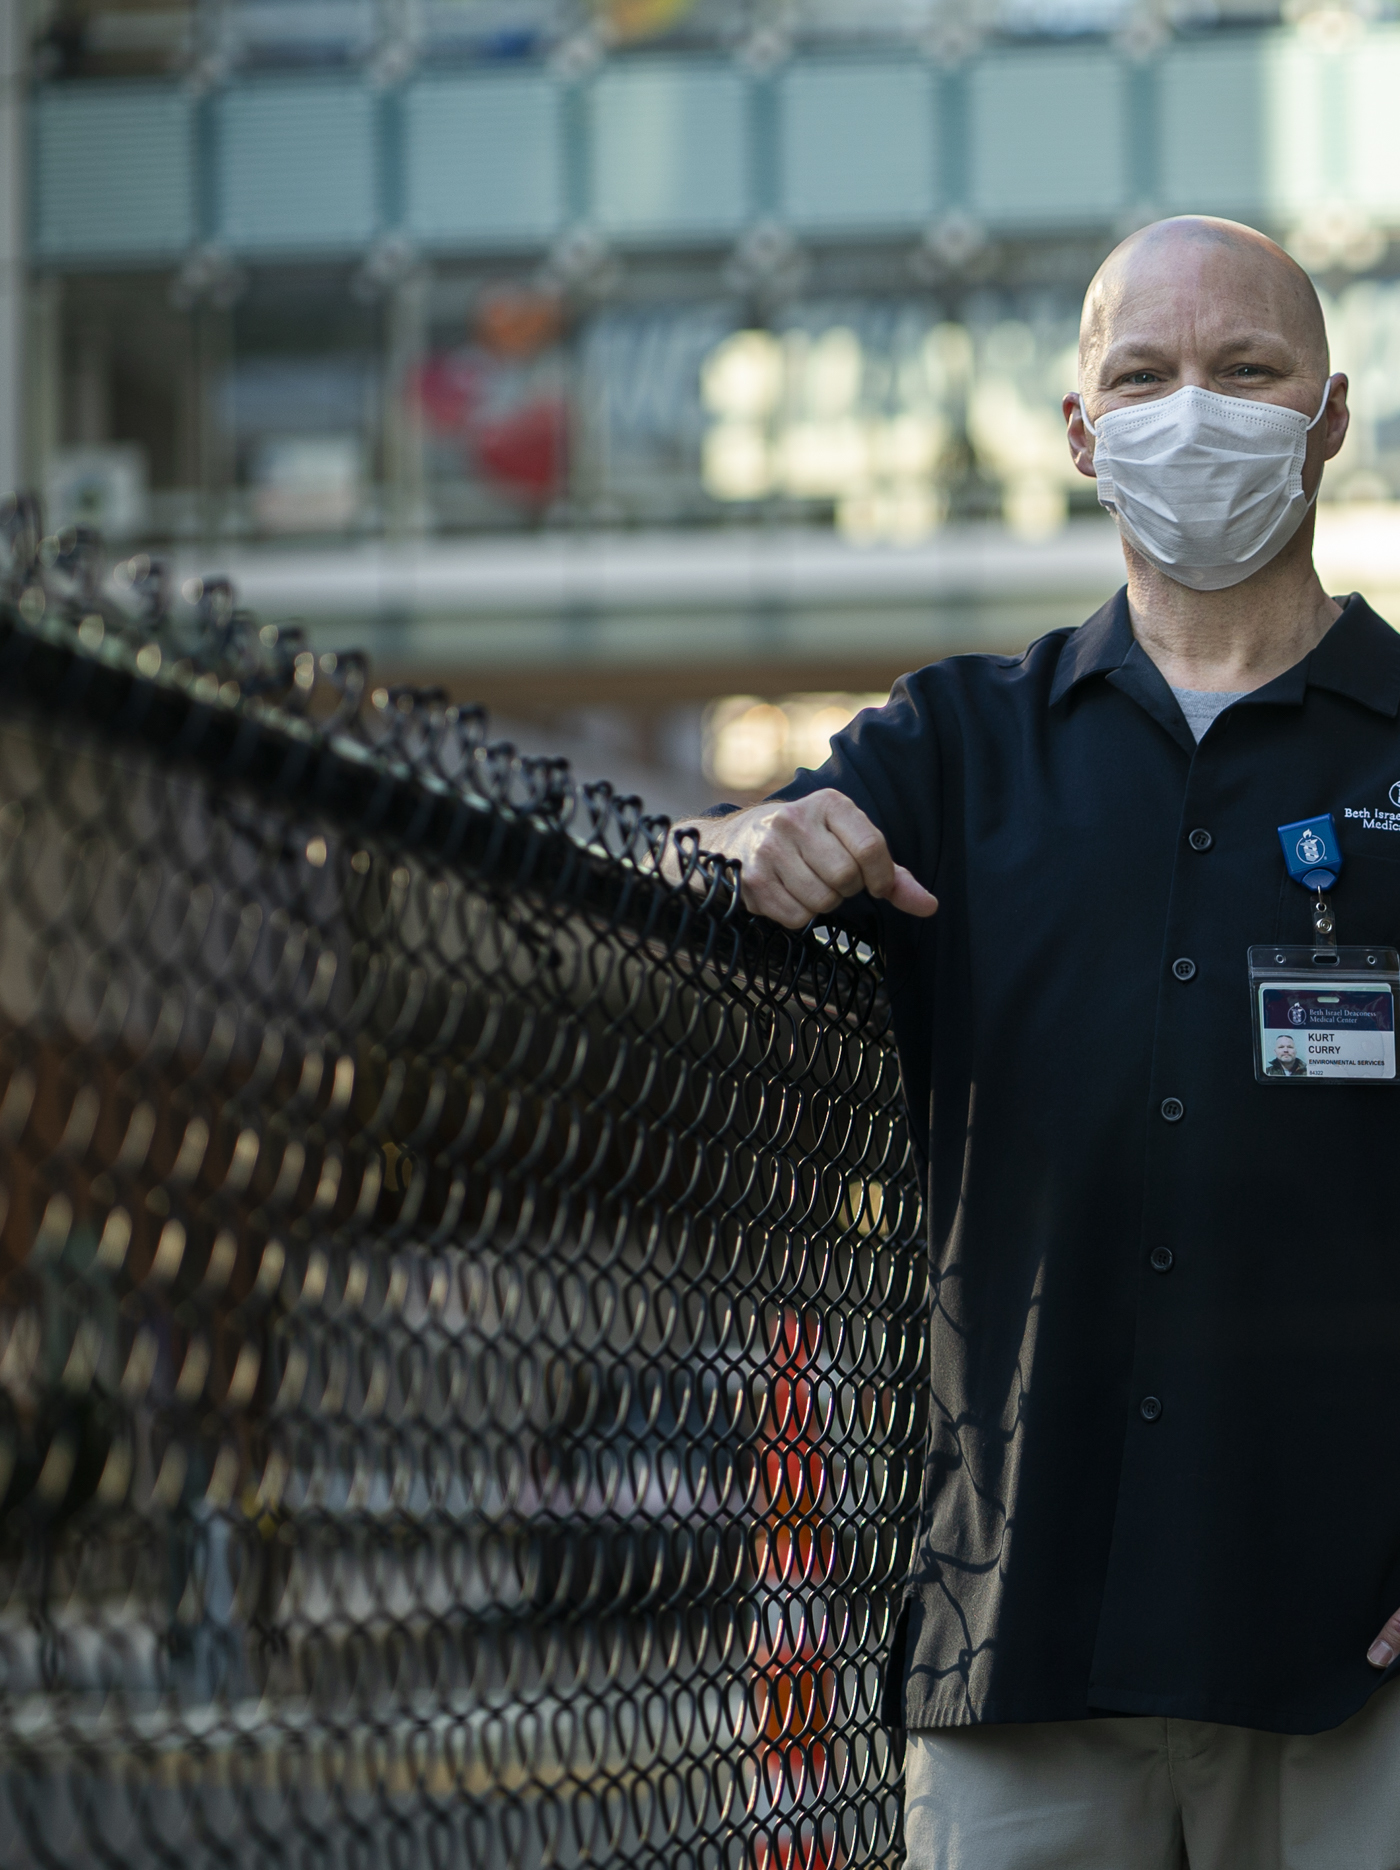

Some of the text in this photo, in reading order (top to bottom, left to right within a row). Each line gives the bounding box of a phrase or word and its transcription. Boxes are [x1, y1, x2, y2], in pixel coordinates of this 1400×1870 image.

[1344, 808, 1370, 819] Beth
[1344, 1009, 1377, 1017] Deaconess
[1308, 1033, 1335, 1042] KURT
[1308, 1045, 1341, 1054] CURRY
